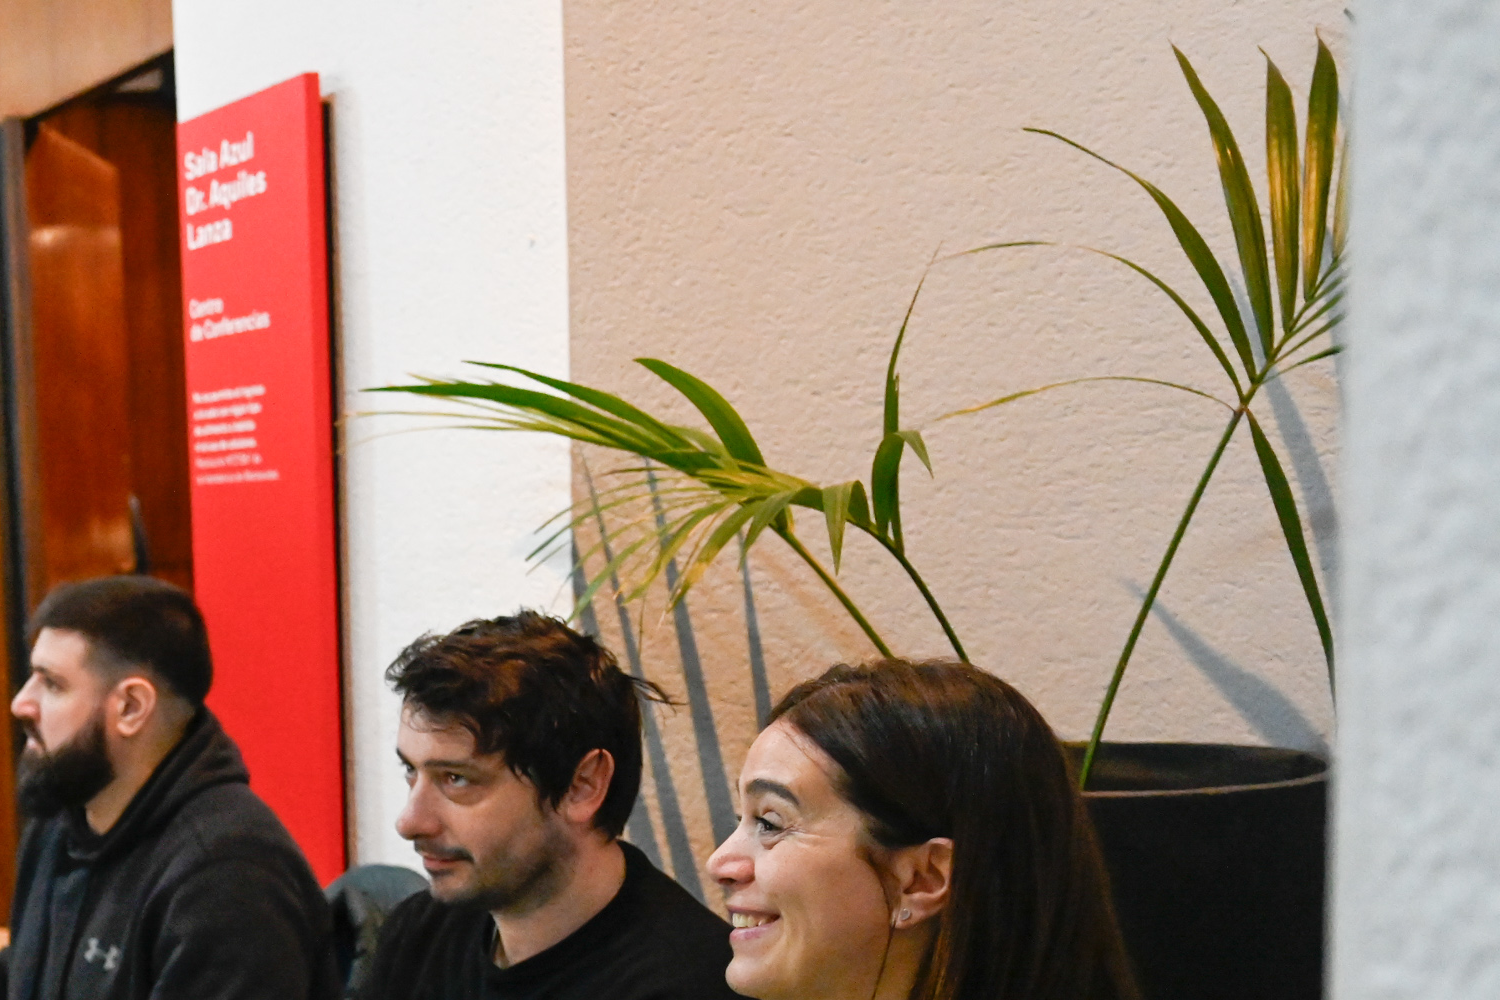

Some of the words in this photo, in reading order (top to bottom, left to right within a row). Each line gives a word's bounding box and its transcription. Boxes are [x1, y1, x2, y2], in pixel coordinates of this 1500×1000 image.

[184, 147, 218, 180] Sala
[219, 130, 254, 168] Azul
[185, 186, 208, 215] Dr.
[209, 169, 267, 210] Aquiles
[186, 218, 232, 250] Lanza
[189, 298, 224, 319] Centro
[204, 310, 271, 340] Conferencias
